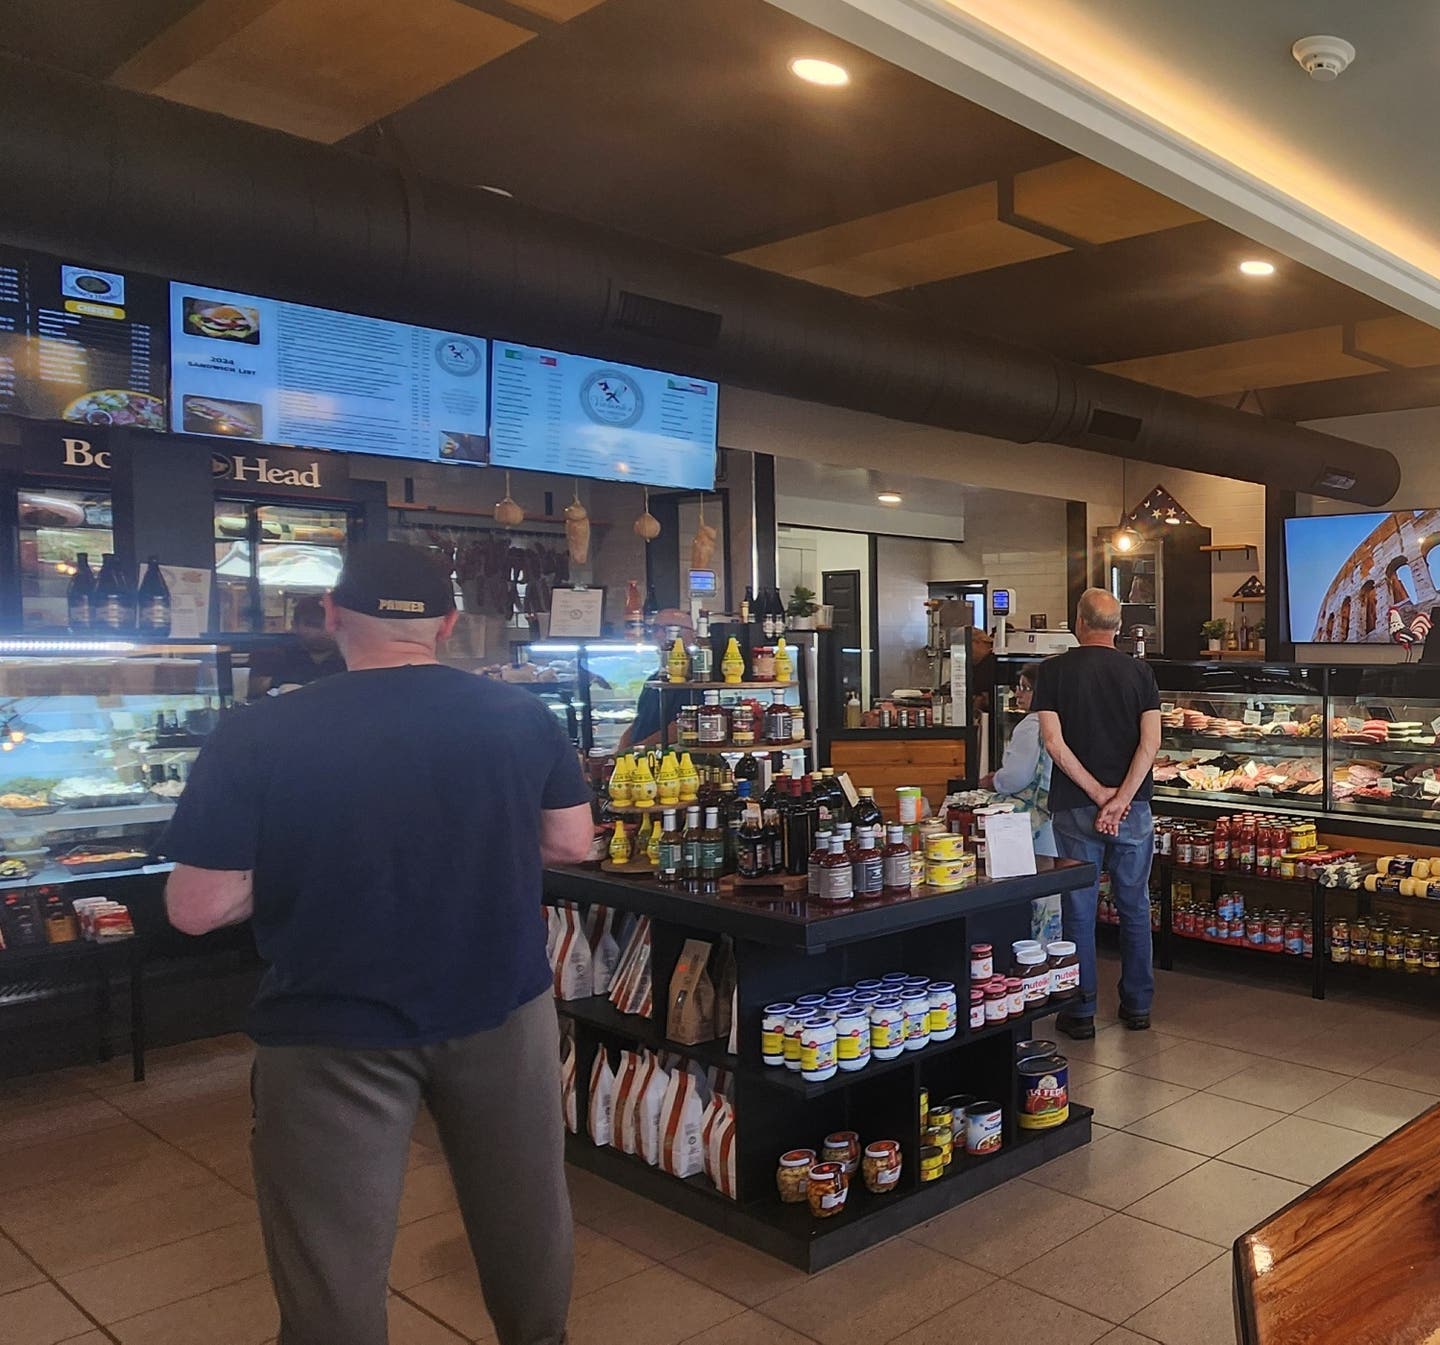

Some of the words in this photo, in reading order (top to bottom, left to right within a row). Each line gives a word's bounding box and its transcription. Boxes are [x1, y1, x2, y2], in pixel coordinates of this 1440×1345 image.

[187, 361, 236, 373] SANDWICH
[238, 368, 257, 376] LIST
[233, 455, 322, 488] Head
